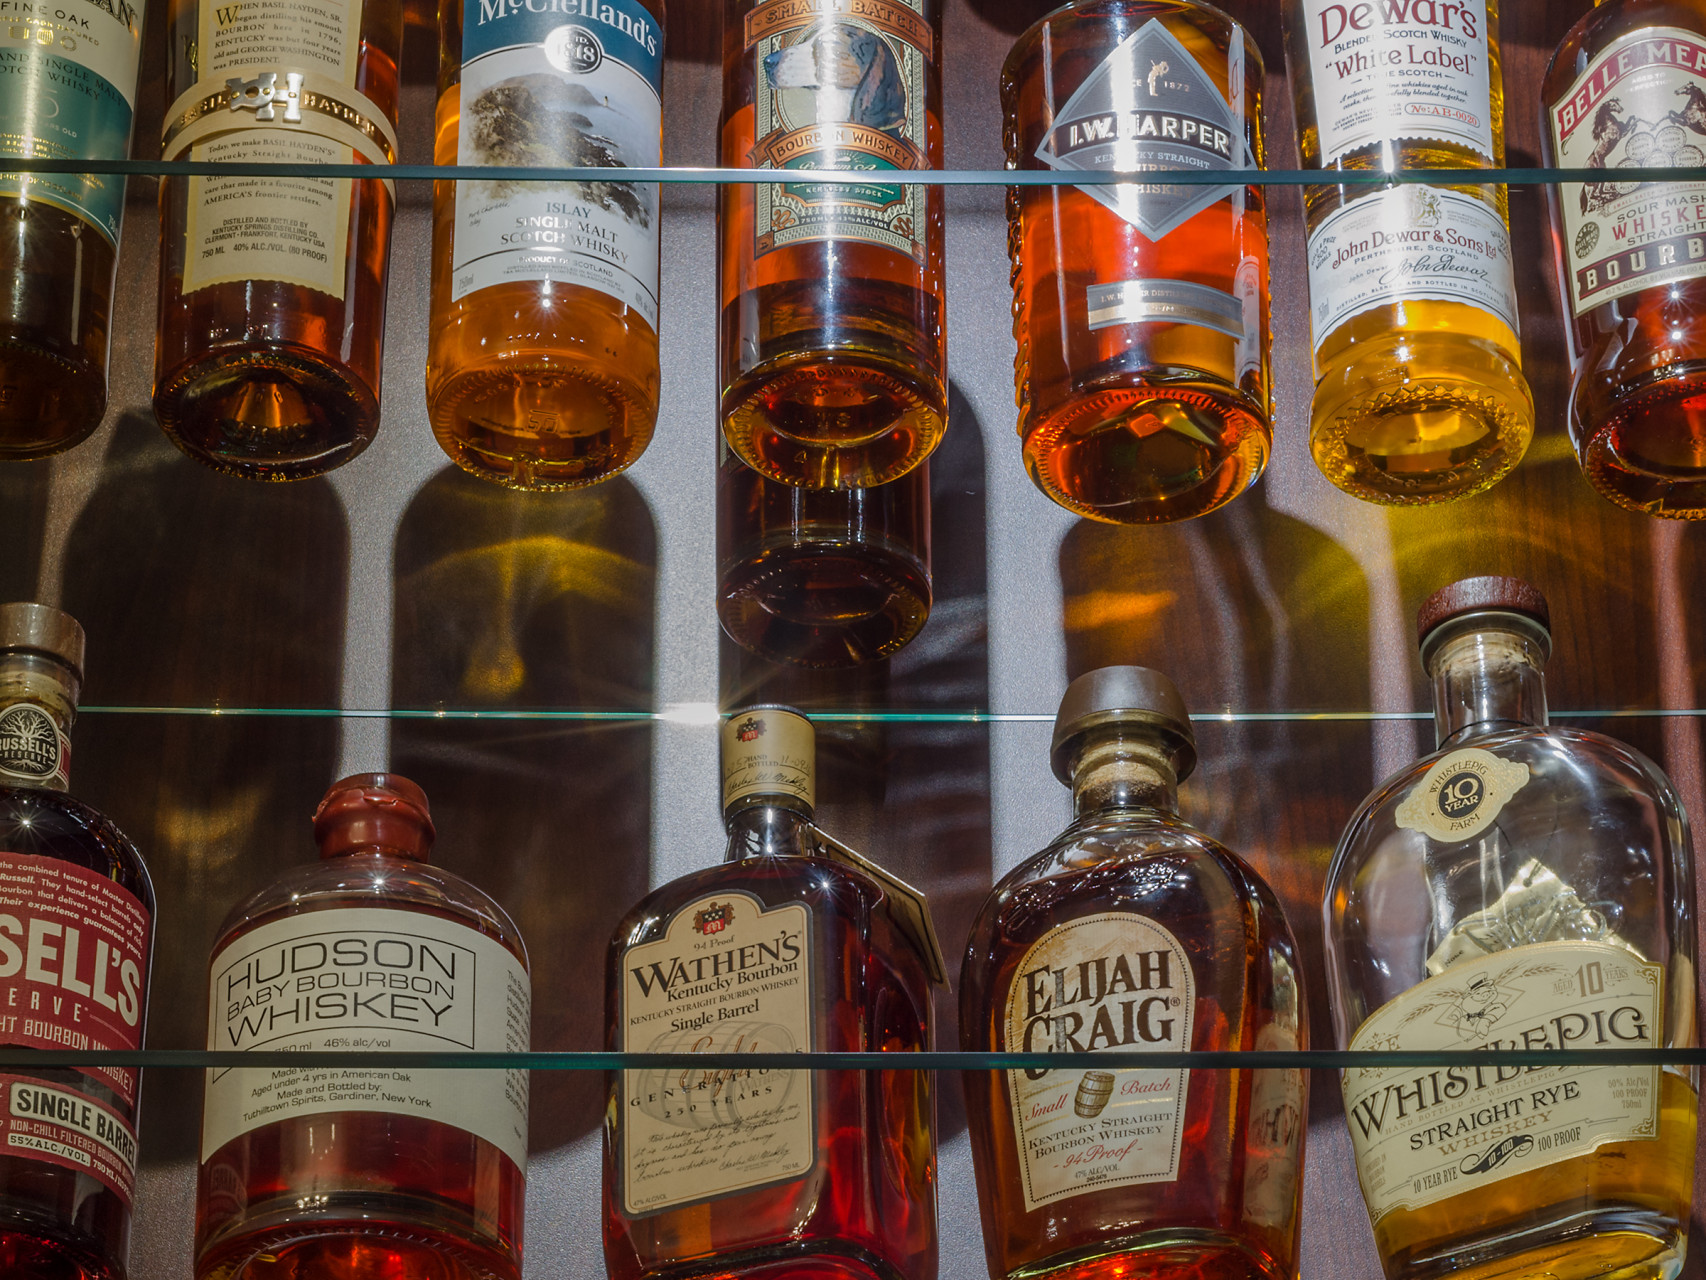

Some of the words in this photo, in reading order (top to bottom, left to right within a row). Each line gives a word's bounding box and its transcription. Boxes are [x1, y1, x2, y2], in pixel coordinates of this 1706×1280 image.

[1, 2, 47, 15] FINE
[55, 10, 90, 29] OAK
[262, 1, 287, 9] BASIL
[289, 2, 328, 17] HAYDEN,
[851, 0, 918, 37] BATCH
[1318, 0, 1477, 49] Dewar's
[1384, 30, 1428, 40] SCOTCH
[1432, 31, 1467, 48] WHISKY
[214, 49, 224, 59] old
[225, 48, 239, 57] and
[240, 45, 276, 54] GEORGE
[278, 46, 340, 66] WASHINGTON
[47, 71, 101, 101] WHISKY
[1398, 70, 1442, 78] SCOTCH
[1563, 56, 1634, 133] BELLE
[852, 131, 908, 163] WHISKEY
[1070, 117, 1113, 147] I.W.
[1157, 152, 1210, 169] STRAIGHT
[546, 202, 591, 218] ISLAY
[1617, 202, 1661, 222] SOUR
[501, 231, 565, 244] SCOTCH
[572, 236, 628, 264] WHISKY
[578, 222, 618, 243] MALT
[1332, 236, 1368, 269] John
[1373, 231, 1427, 250] Dewar
[1433, 231, 1444, 242] &
[1446, 229, 1484, 252] Sons
[5, 751, 46, 764] RESERVE
[1430, 761, 1488, 793] WHISTLEPIG
[1444, 778, 1478, 804] 10
[1445, 795, 1478, 812] YEAR
[1450, 813, 1480, 830] FARM
[0, 873, 35, 883] Russell.
[42, 879, 61, 890] They
[66, 885, 108, 907] hand-select
[18, 864, 59, 876] combined
[63, 873, 87, 886] tenure
[103, 888, 123, 905] Master
[0, 897, 23, 905] Their
[28, 901, 79, 919] experience
[84, 917, 124, 943] guarantees
[228, 939, 455, 1001] HUDSON
[630, 931, 801, 997] WATHEN'S
[228, 980, 290, 1022] BABY
[297, 972, 454, 1000] BOURBON
[667, 978, 735, 1002] Kentucky
[738, 962, 798, 984] Bourbon
[1022, 949, 1173, 1022] ELIJAH
[630, 1009, 674, 1026] KENTUCKY
[676, 998, 717, 1014] STRAIGHT
[719, 988, 759, 1002] BOURBON
[761, 977, 799, 990] WHISKEY
[670, 1012, 714, 1033] Single
[717, 999, 759, 1019] Barrel
[228, 992, 453, 1047] WHISKEY
[324, 1039, 350, 1048] 46%
[353, 1038, 391, 1048] alc/vol
[1022, 997, 1175, 1081] CRAIG
[251, 1083, 273, 1097] Aged
[274, 1078, 301, 1089] under
[303, 1074, 309, 1083] 4
[312, 1074, 328, 1083] yrs
[330, 1071, 338, 1079] in
[341, 1070, 389, 1079] American
[392, 1073, 411, 1082] Oak
[1120, 1079, 1172, 1095] Batch
[17, 1089, 91, 1131] SINGLE
[243, 1101, 289, 1122] Tuthilltown
[382, 1093, 406, 1103] New
[408, 1095, 431, 1108] York
[1025, 1094, 1068, 1121] Small
[1410, 1098, 1524, 1151] STRAIGHT
[1530, 1081, 1581, 1110] RYE
[10, 1120, 58, 1139] NON-CHILL
[61, 1131, 97, 1154] FILTERED
[1028, 1122, 1097, 1148] KENTUCKY
[1101, 1113, 1172, 1129] STRAIGHT
[1036, 1136, 1095, 1160] BOURBON
[1098, 1126, 1163, 1142] WHISKEY
[1437, 1110, 1554, 1156] WHISKEY
[1537, 1137, 1552, 1151] 100
[1552, 1127, 1582, 1146] PROOF
